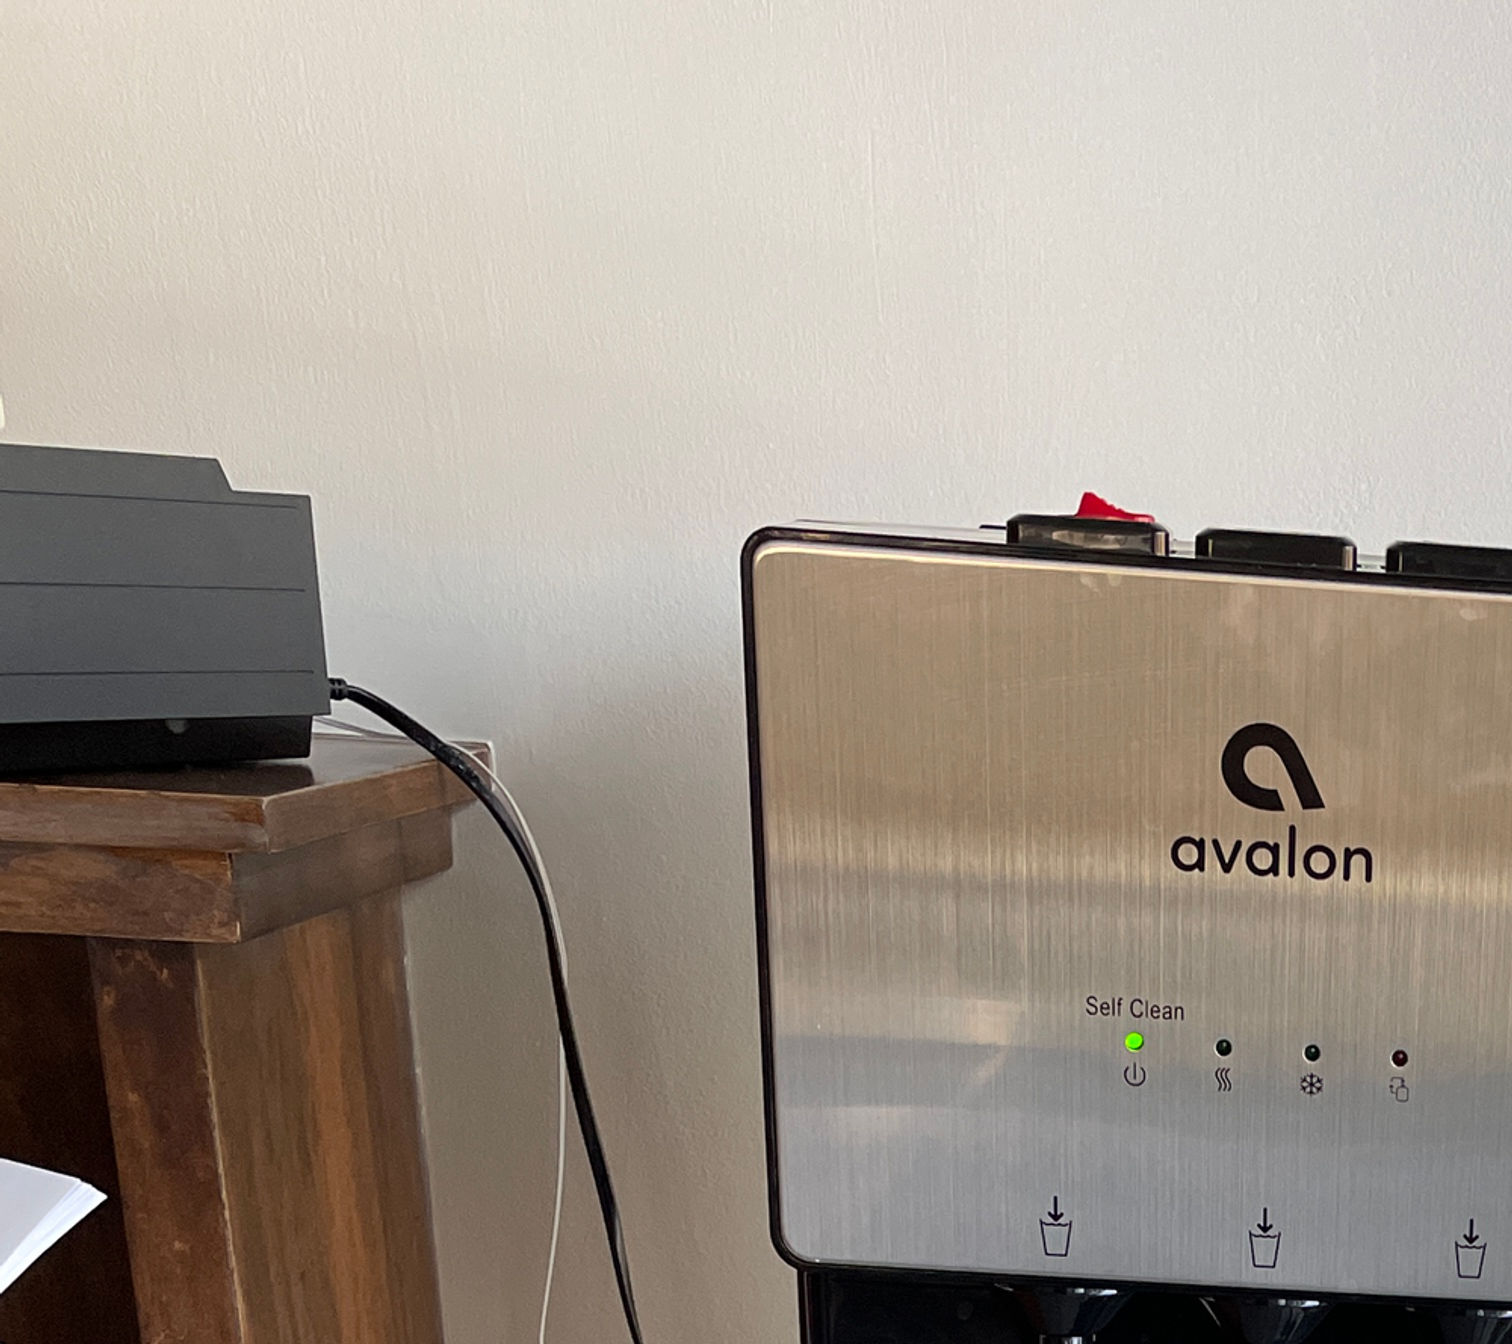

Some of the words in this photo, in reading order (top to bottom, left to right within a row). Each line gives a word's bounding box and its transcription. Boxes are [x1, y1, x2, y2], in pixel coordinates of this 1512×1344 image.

[1170, 823, 1373, 884] avalon
[1085, 995, 1123, 1017] Self
[1129, 998, 1185, 1021] Clean
